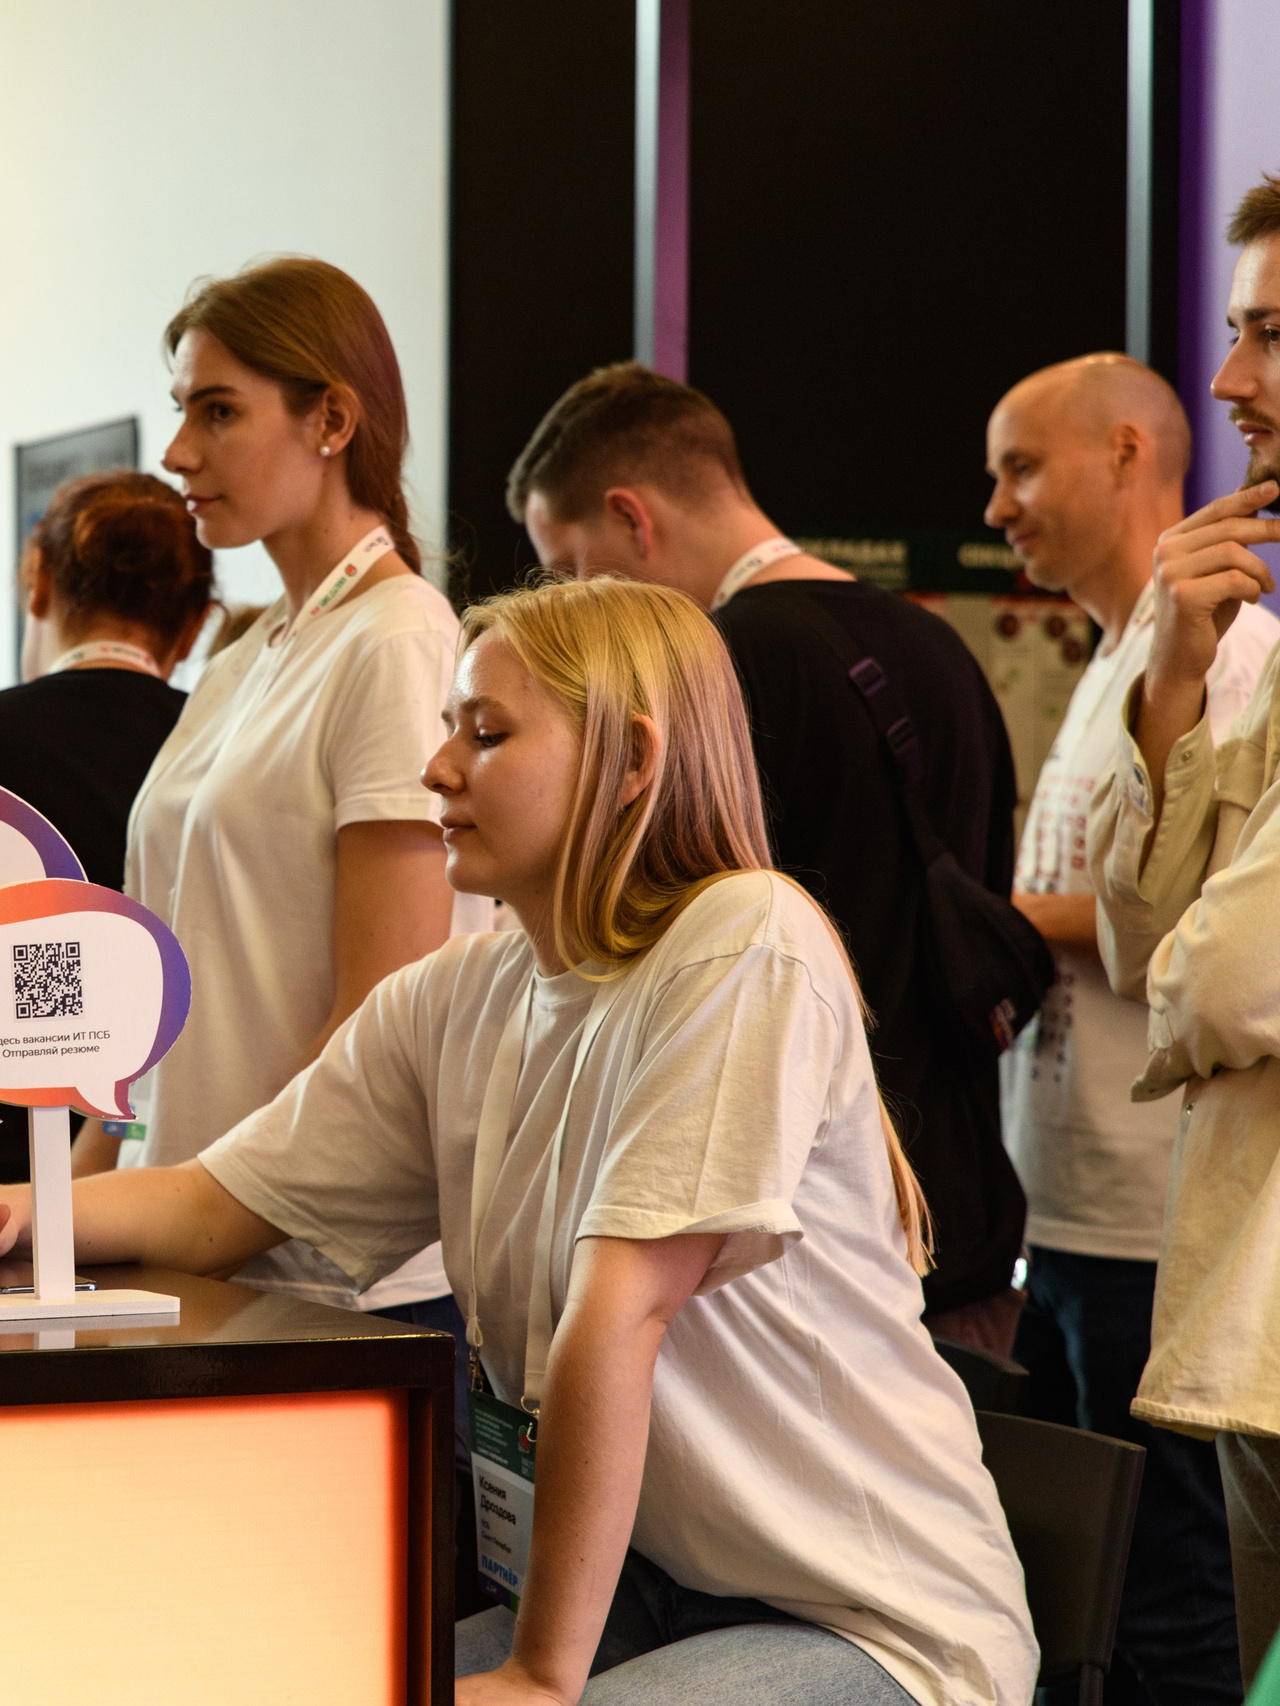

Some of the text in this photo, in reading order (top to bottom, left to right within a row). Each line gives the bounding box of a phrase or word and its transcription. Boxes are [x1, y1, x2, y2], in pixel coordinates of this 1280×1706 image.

[22, 1032, 71, 1045] вакансии
[72, 1031, 87, 1041] ИТ
[88, 1029, 111, 1040] ПСБ
[2, 1044, 100, 1058] Отправляй резюме
[478, 1474, 507, 1501] Ксения
[480, 1494, 517, 1525] Дроздова
